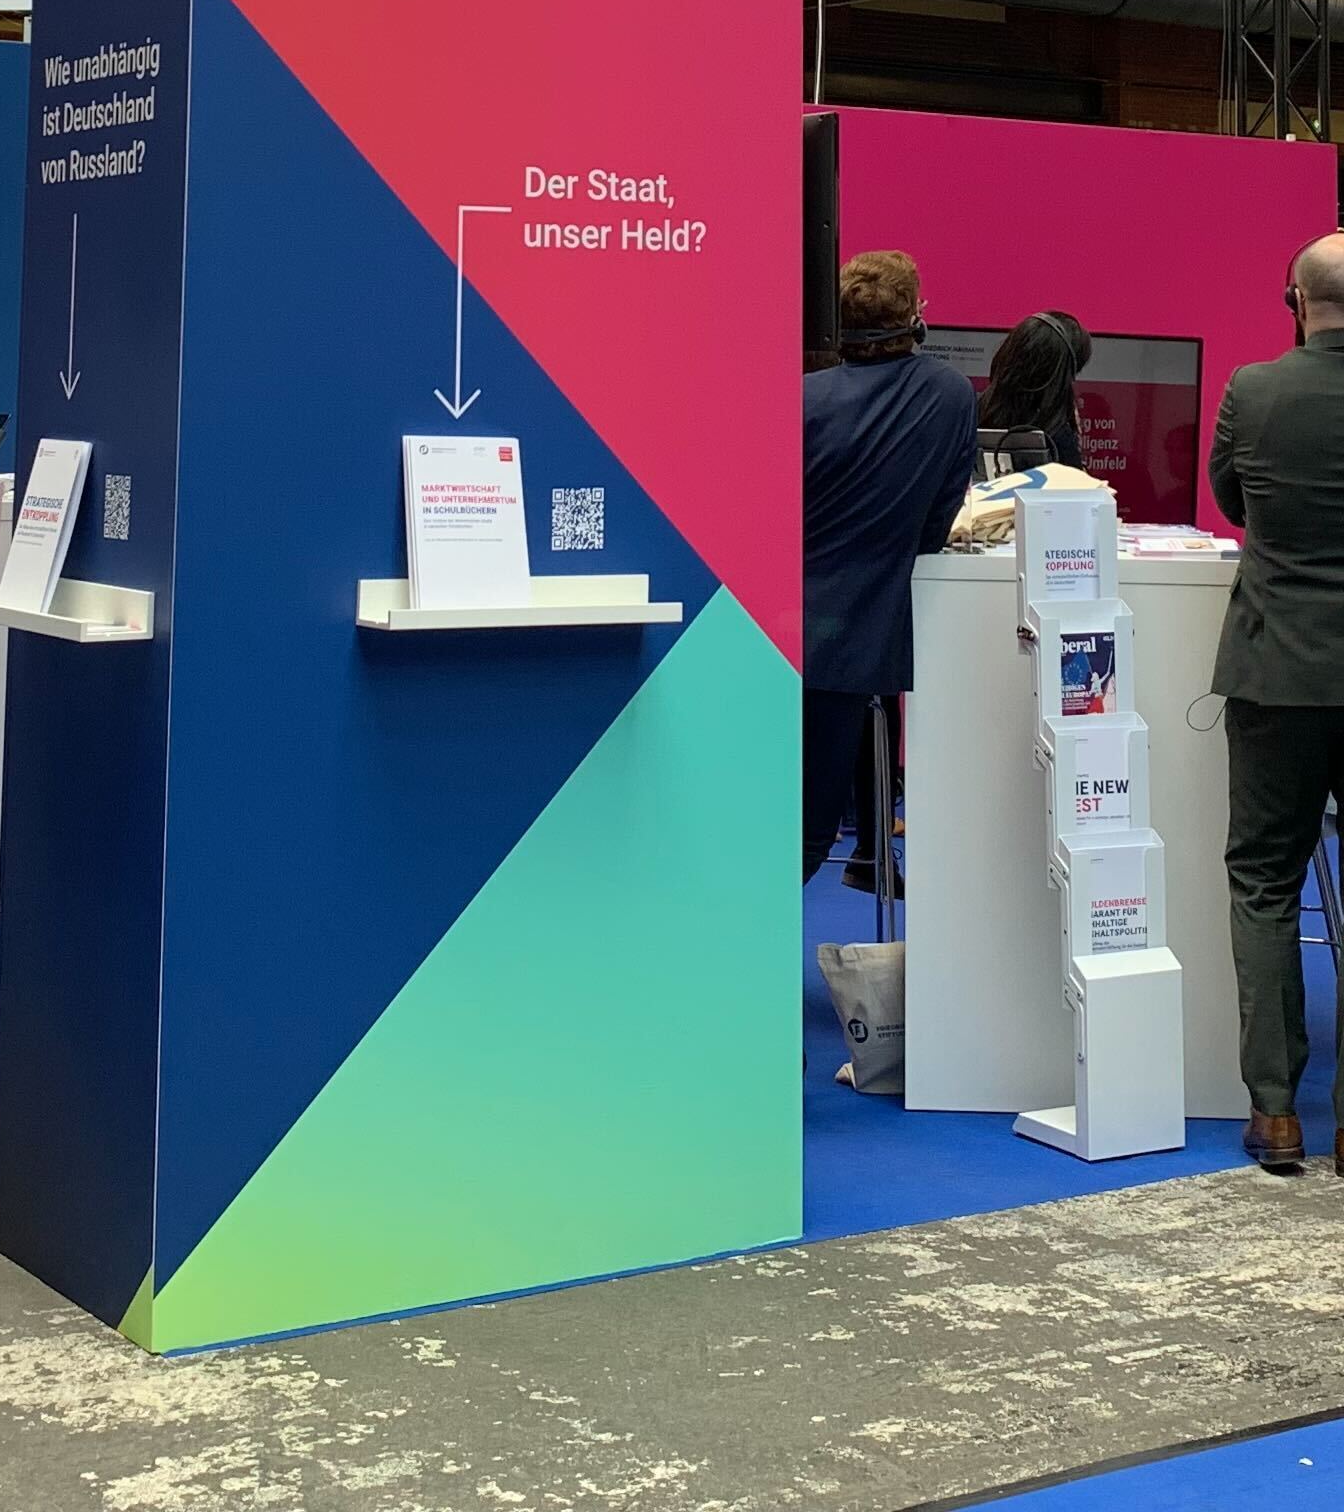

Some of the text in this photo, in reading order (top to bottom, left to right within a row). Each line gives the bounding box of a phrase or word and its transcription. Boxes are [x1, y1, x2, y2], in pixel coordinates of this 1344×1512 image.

[44, 36, 161, 89] Wie unabhängig
[42, 85, 155, 137] ist Deutschland
[40, 139, 146, 185] von Russland?
[525, 166, 674, 209] Der Staat,
[524, 219, 707, 252] unser Held?
[1094, 418, 1116, 430] von
[421, 484, 501, 493] MARKTWIRTSCHAFT
[422, 495, 517, 504] UND UNTERNEHMERTUM
[422, 506, 497, 514] IN SCHULBÜCHERN
[1093, 779, 1129, 795] NEW
[1122, 907, 1138, 916] FÜR
